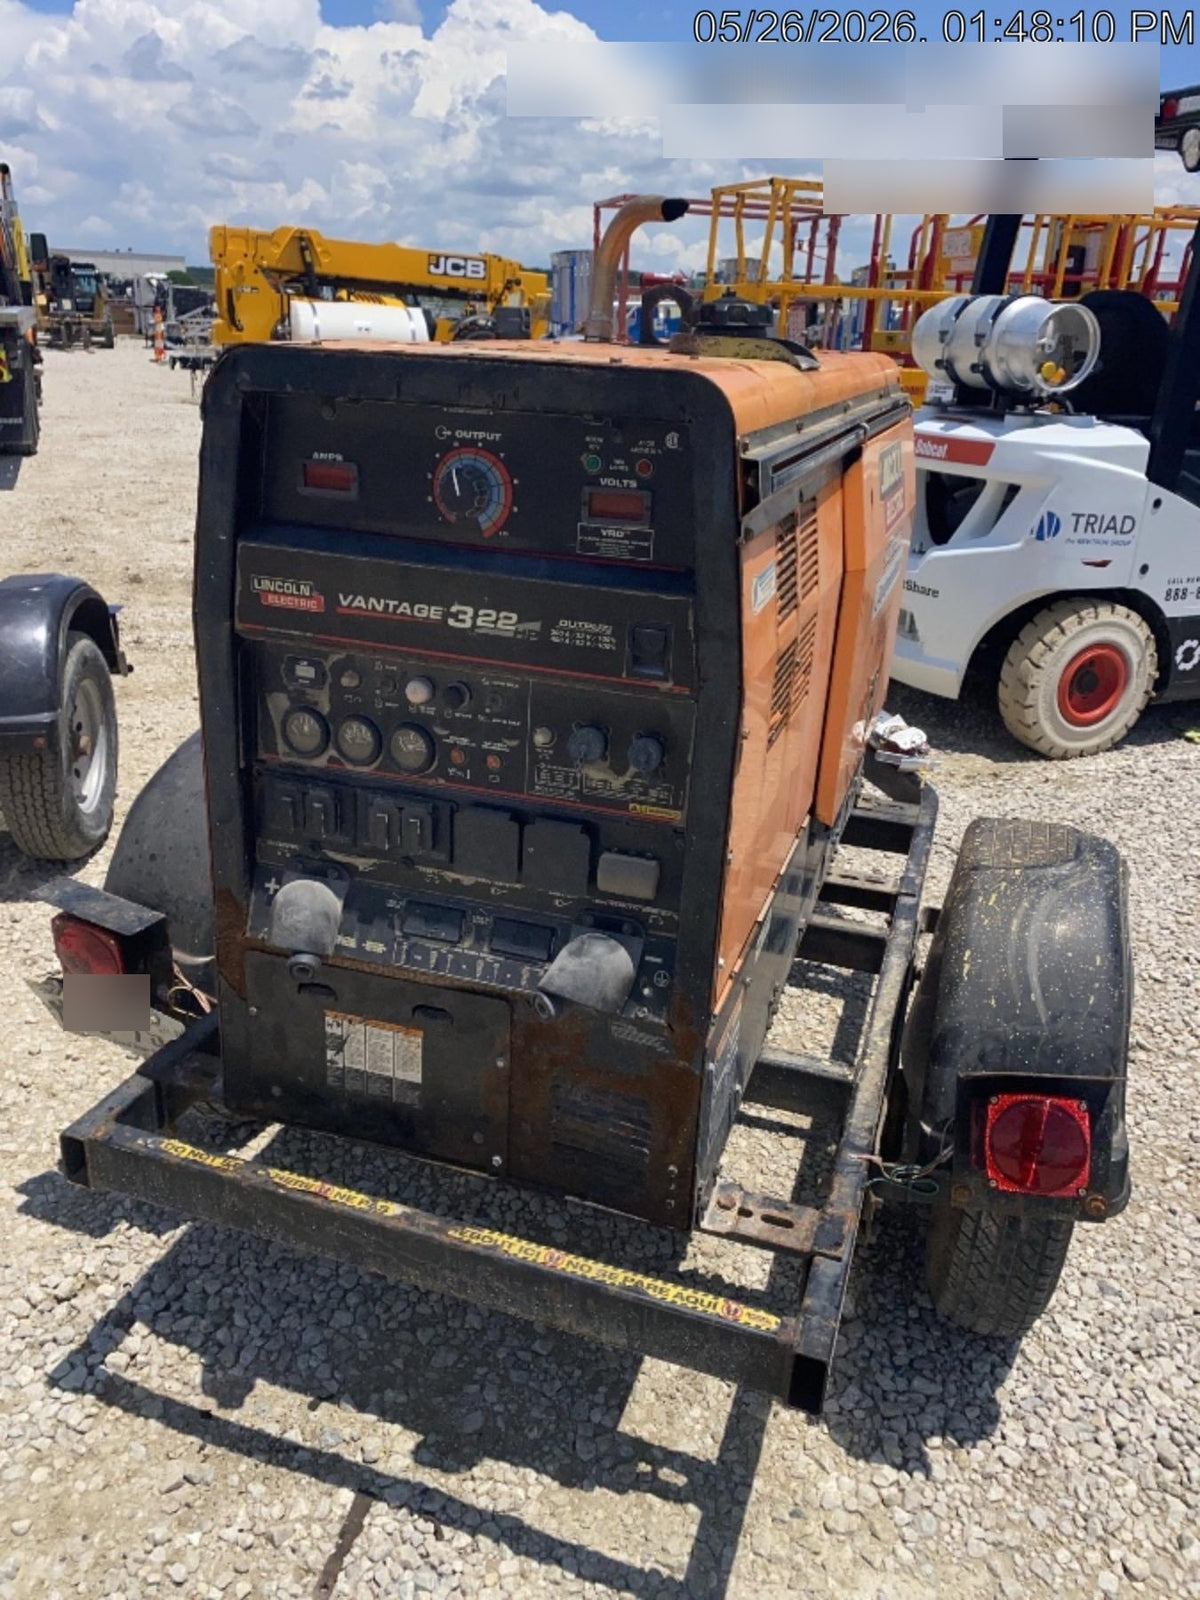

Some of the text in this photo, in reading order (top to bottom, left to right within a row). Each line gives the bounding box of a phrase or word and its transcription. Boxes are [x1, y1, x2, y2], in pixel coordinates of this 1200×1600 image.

[430, 256, 485, 278] JCB
[455, 429, 502, 441] OUTPUT
[312, 451, 344, 462] AMPS
[915, 438, 949, 459] Bobcat
[600, 477, 637, 488] VOLTS
[1071, 513, 1136, 535] TRIAD
[253, 578, 311, 596] LINCOLN
[267, 593, 318, 609] ELECTRIC
[338, 592, 519, 631] VANTAGE 322
[164, 1142, 217, 1163] DO NOT
[565, 1259, 593, 1274] NO
[596, 1268, 618, 1281] SE
[621, 1275, 671, 1298] PARE
[672, 1291, 718, 1311] AQUI
